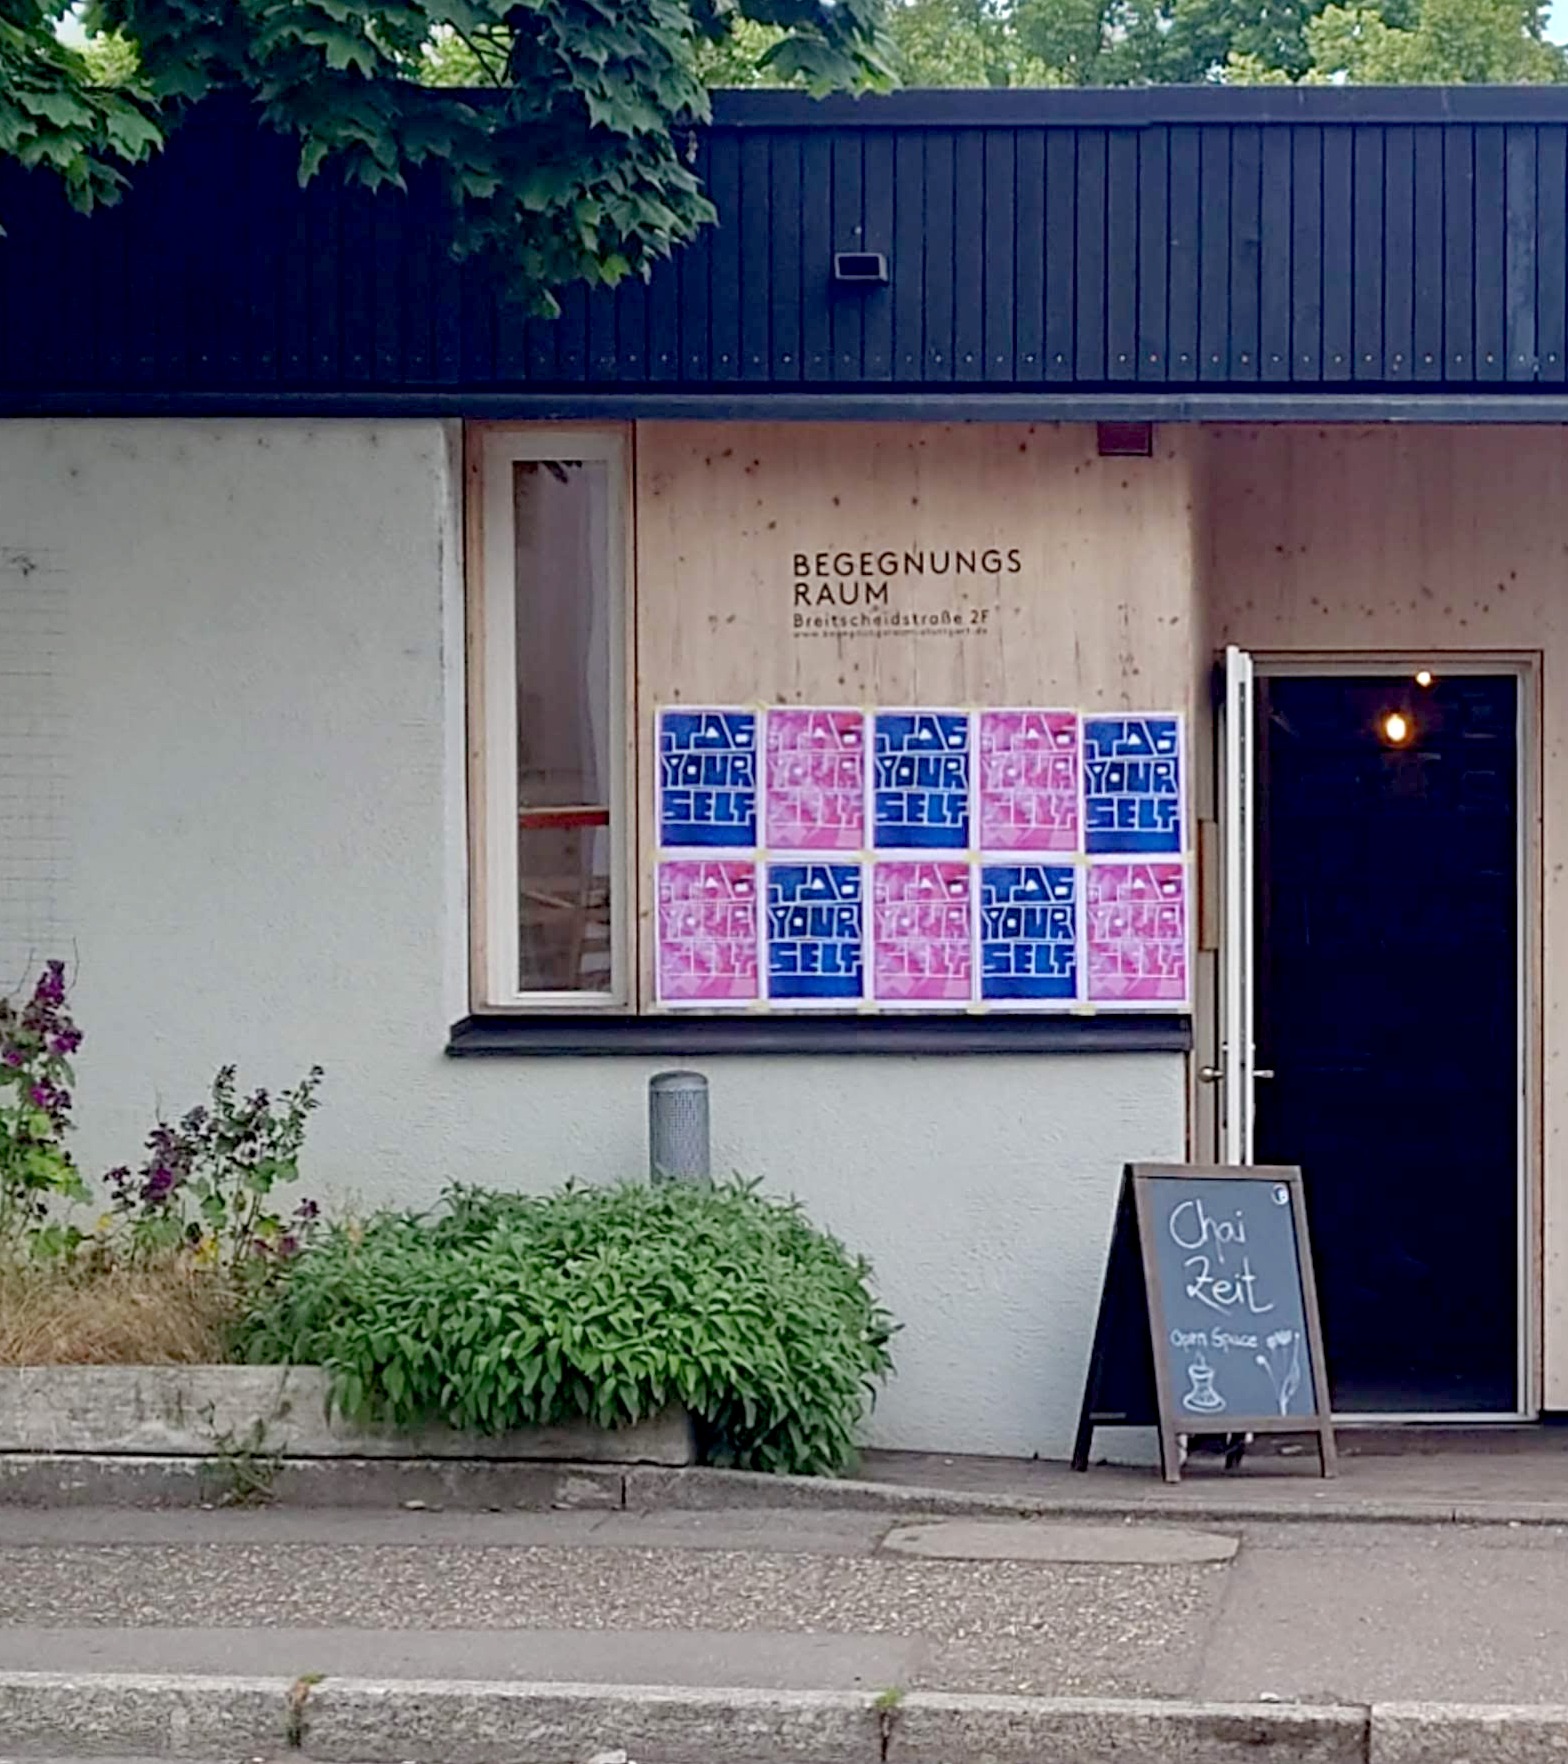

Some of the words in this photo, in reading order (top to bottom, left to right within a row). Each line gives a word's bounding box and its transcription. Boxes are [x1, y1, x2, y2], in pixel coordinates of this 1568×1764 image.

[793, 549, 1021, 577] BEGEGNUNGS
[793, 581, 888, 606] RAUM
[793, 609, 962, 629] Breitscheidstraße
[970, 608, 990, 625] 2F
[662, 754, 755, 787] YOUR
[876, 755, 969, 790] YOUR
[1085, 760, 1178, 794] YOUR
[662, 790, 755, 825] SELF
[876, 792, 969, 826] SELF
[1085, 797, 1178, 832] SELF
[768, 906, 862, 941] YOUR
[983, 906, 1075, 942] YOUR
[768, 943, 862, 977] SELF
[983, 943, 1075, 978] SELF
[1169, 1199, 1246, 1264] Chai
[1184, 1256, 1275, 1316] Zeit
